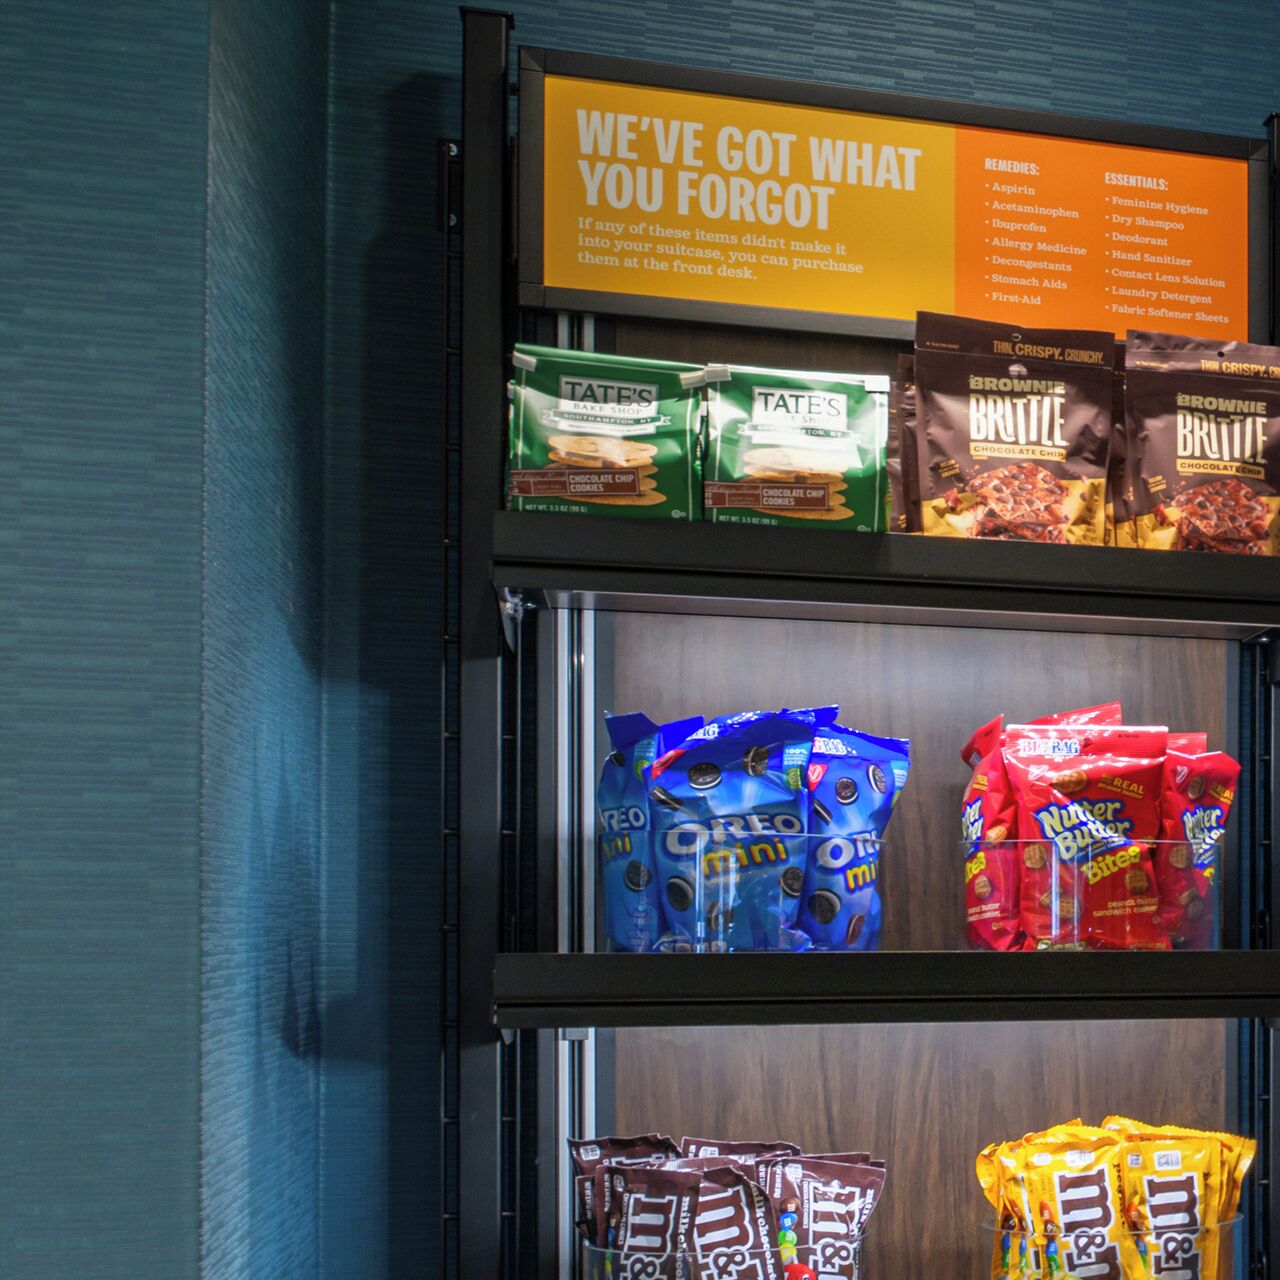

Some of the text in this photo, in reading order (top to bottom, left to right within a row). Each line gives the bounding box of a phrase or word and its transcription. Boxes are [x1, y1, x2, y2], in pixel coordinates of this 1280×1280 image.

[716, 125, 797, 177] GOT
[809, 136, 922, 191] WHAT
[985, 158, 1040, 176] REMEDIES:
[992, 182, 1036, 196] Aspirin
[1104, 172, 1168, 191] ESSENTIALS:
[577, 159, 836, 231] YOU FORGOT
[992, 200, 1079, 219] Acetaminophen
[1112, 196, 1209, 216] Feminine Hygiene
[992, 218, 1047, 233] Ibuprofen
[1112, 214, 1185, 231] Dry Shampoo
[578, 216, 592, 230] If
[594, 221, 625, 236] any
[629, 222, 648, 235] of
[649, 225, 691, 241] these
[695, 228, 738, 245] items
[790, 239, 830, 254] make
[831, 242, 847, 256] it
[1112, 232, 1169, 247] Deodorant
[578, 233, 864, 274] into your suitcase, you can purchase
[992, 237, 1088, 256] Allergy Medicine
[578, 251, 758, 280] them at the front desk.
[992, 255, 1073, 273] Decongestants
[1112, 250, 1193, 267] Hand Sanitizer
[992, 273, 1068, 290] Stomach Aids
[1111, 268, 1226, 288] Contact Lens Solution
[992, 292, 1041, 305] First-Aid
[1112, 287, 1213, 305] Laundry Detergent
[1112, 304, 1230, 324] Fabric Softener Sheets
[564, 381, 653, 408] TATE'S
[970, 376, 1066, 394] BROWNIE
[573, 402, 643, 416] BAKE SHOP
[757, 391, 841, 417] TATE'S
[1176, 394, 1267, 415] BROWNIE
[969, 393, 1069, 447] BRITTLE
[1176, 409, 1268, 465] BRITTLE
[973, 445, 1065, 458] CHOCOLATE CHIP
[569, 474, 614, 484] CHOCOLATE
[614, 475, 635, 484] CHIP
[570, 484, 604, 492] COOKIES
[1040, 799, 1121, 838] Nutter
[665, 813, 803, 855] OREO
[1053, 820, 1131, 861] Butter
[703, 836, 787, 878] mini
[1080, 845, 1141, 885] Bites
